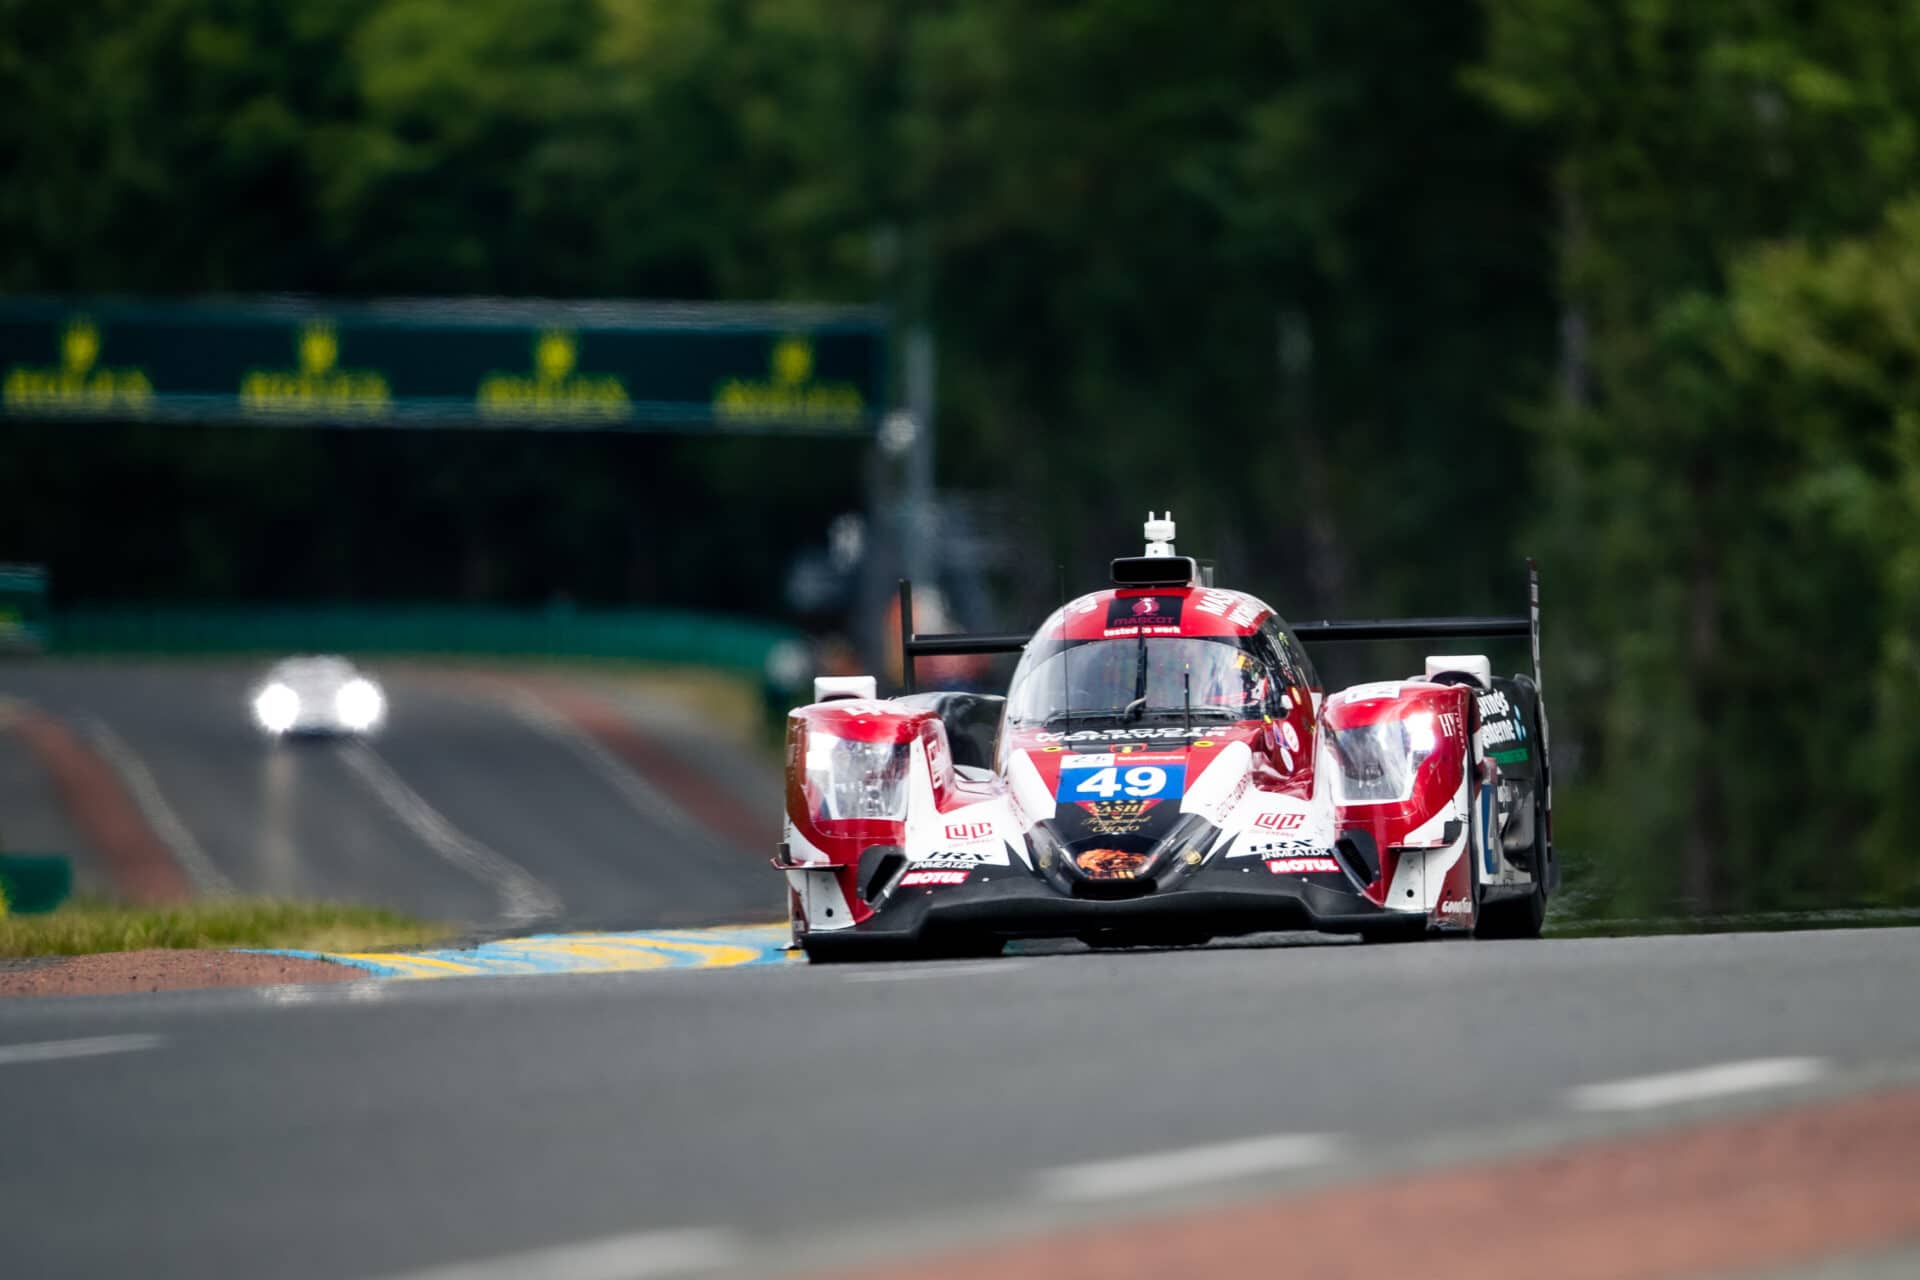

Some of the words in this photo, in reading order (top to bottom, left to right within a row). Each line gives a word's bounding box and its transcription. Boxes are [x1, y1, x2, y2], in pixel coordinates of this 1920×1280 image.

[1075, 766, 1168, 798] 49
[1270, 858, 1340, 874] MOTUL
[901, 870, 966, 885] MOTUL
